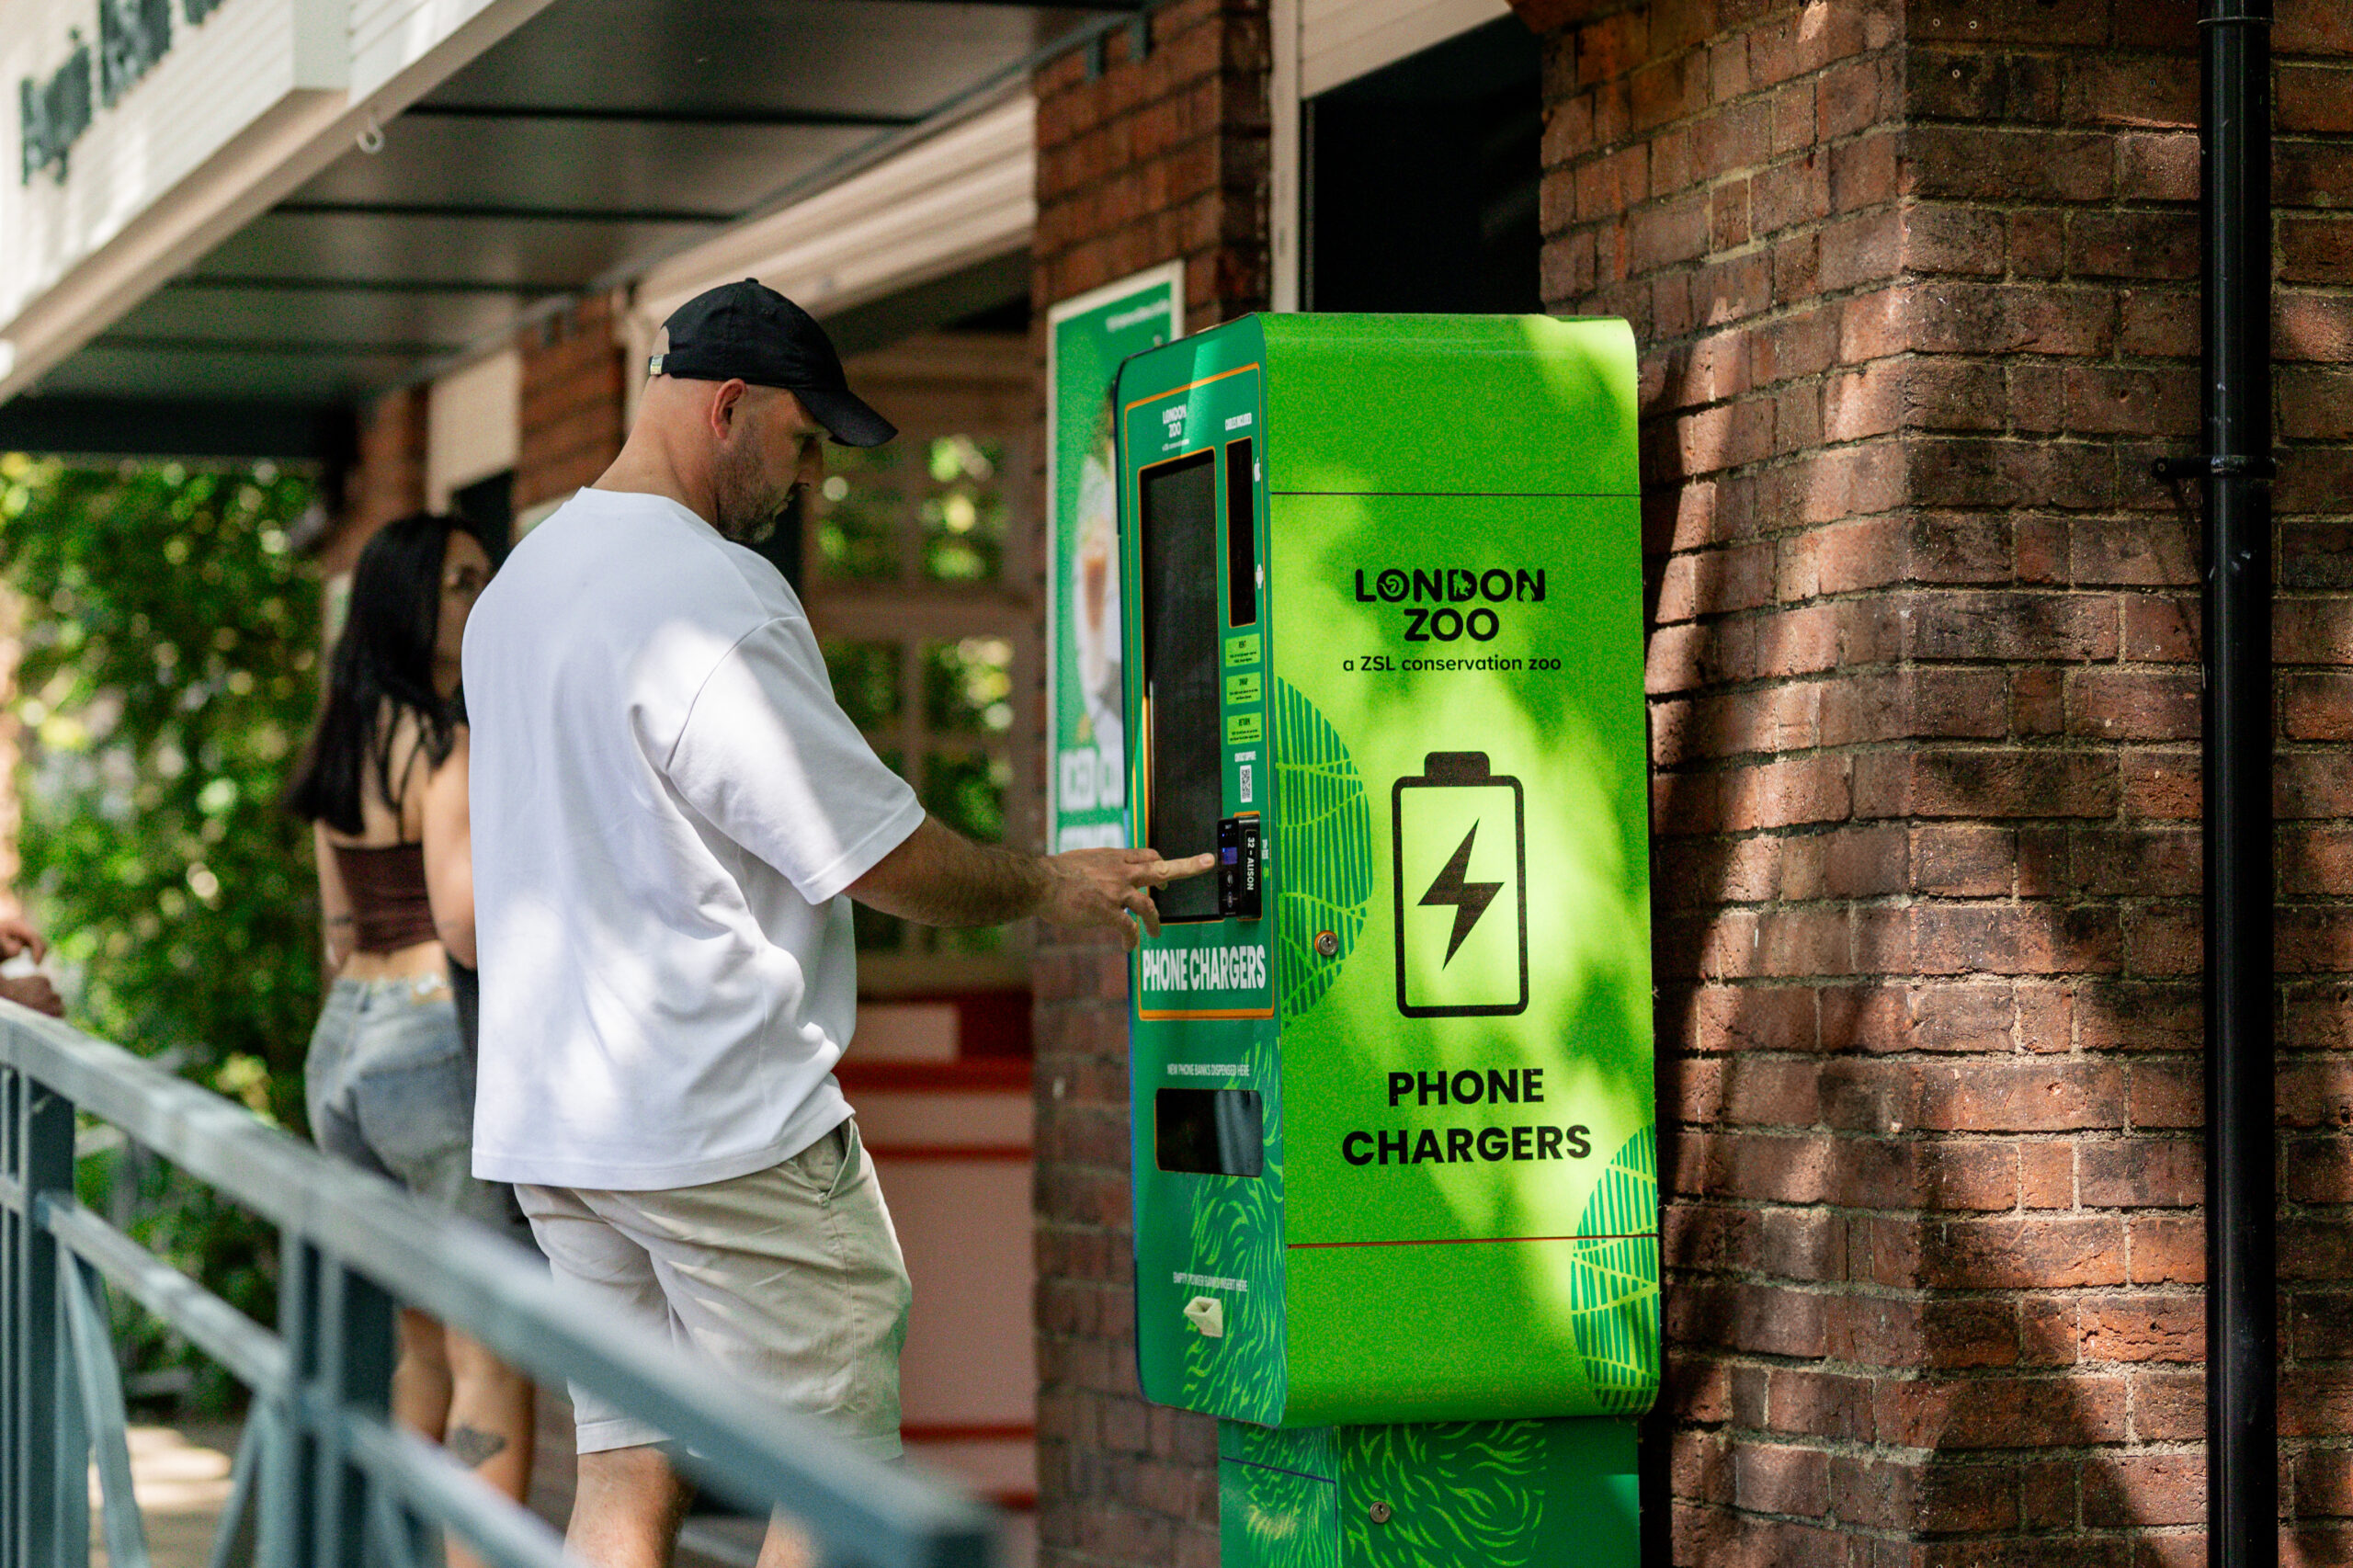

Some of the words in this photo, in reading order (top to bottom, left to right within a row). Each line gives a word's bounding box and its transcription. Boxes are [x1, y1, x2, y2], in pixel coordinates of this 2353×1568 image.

[1162, 403, 1187, 425] LONDON
[1168, 421, 1182, 438] ZOO
[1356, 569, 1545, 602] LONDON
[1404, 608, 1500, 642] ZOO
[1343, 659, 1355, 672] a
[1360, 656, 1396, 671] ZSL
[1402, 655, 1523, 671] conservation
[1529, 658, 1562, 671] zoo
[1247, 836, 1256, 848] 32
[1246, 857, 1255, 891] ALISON
[1142, 949, 1188, 992] PHONE
[1189, 944, 1267, 991] CHARGERS
[1388, 1069, 1544, 1107] PHONE
[1342, 1125, 1591, 1165] CHARGERS
